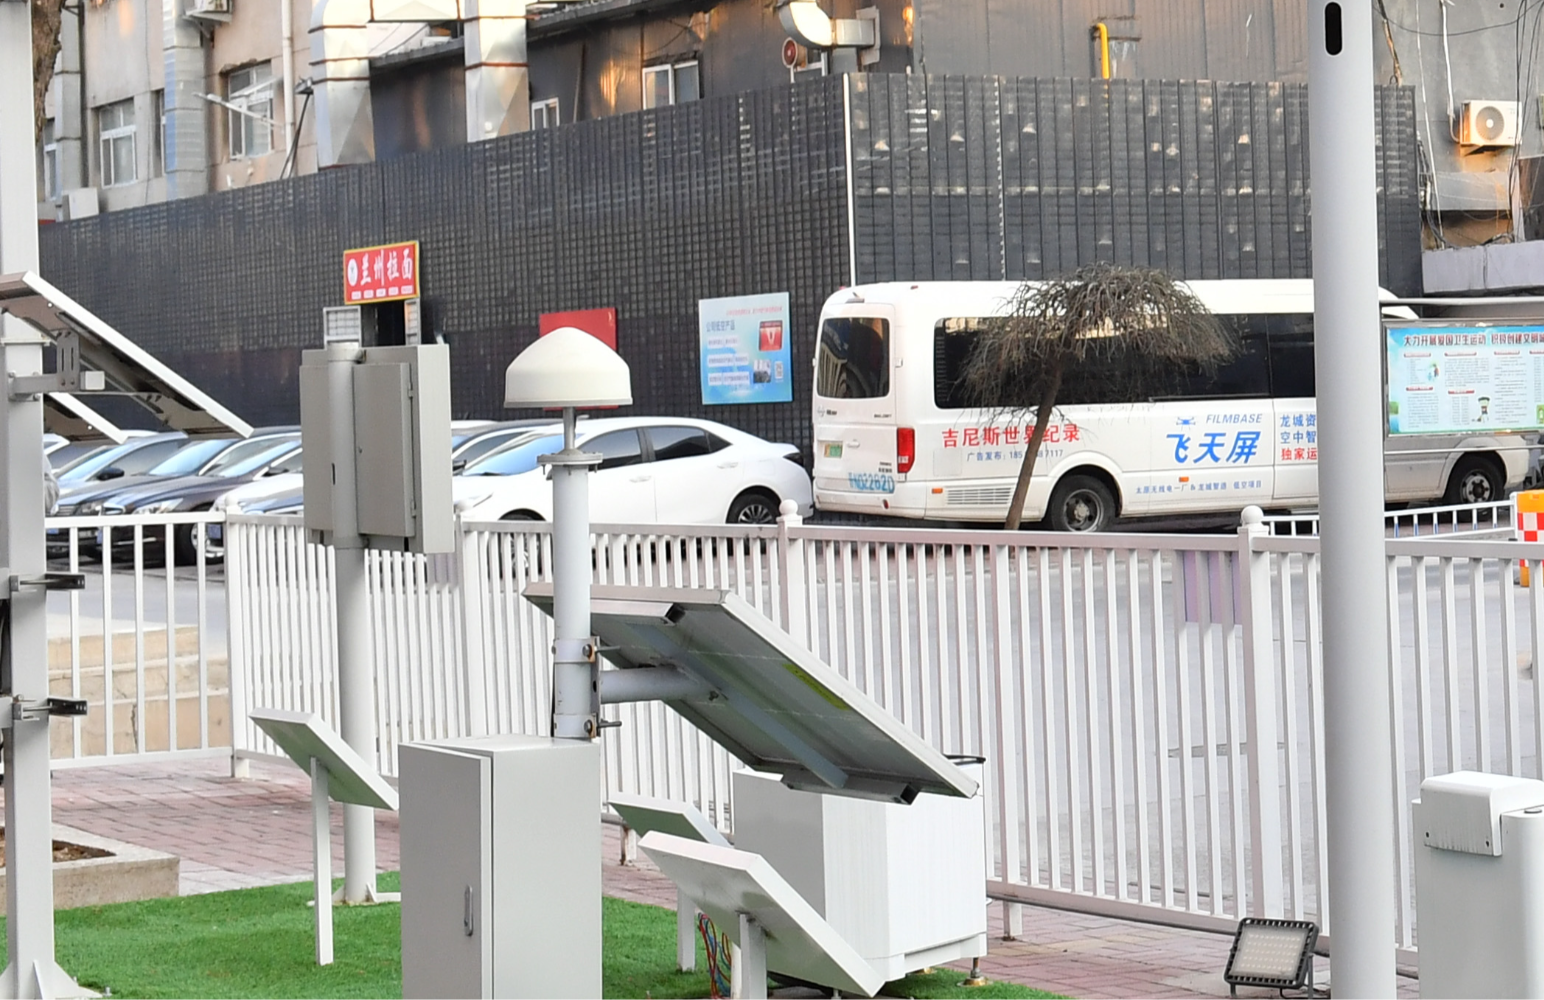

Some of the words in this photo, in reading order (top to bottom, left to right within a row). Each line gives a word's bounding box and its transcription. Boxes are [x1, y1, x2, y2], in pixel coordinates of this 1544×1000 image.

[360, 248, 413, 286] 兰州拉面
[1403, 333, 1486, 347] 大力开展爱国卫生运动
[1206, 413, 1263, 424] FILMBASE
[1280, 413, 1316, 428] 龙城资
[1280, 430, 1316, 444] 空中智
[1166, 431, 1261, 464] 飞天屏
[1281, 447, 1318, 461] 独家运
[1136, 483, 1189, 494] 太原无线电一厂
